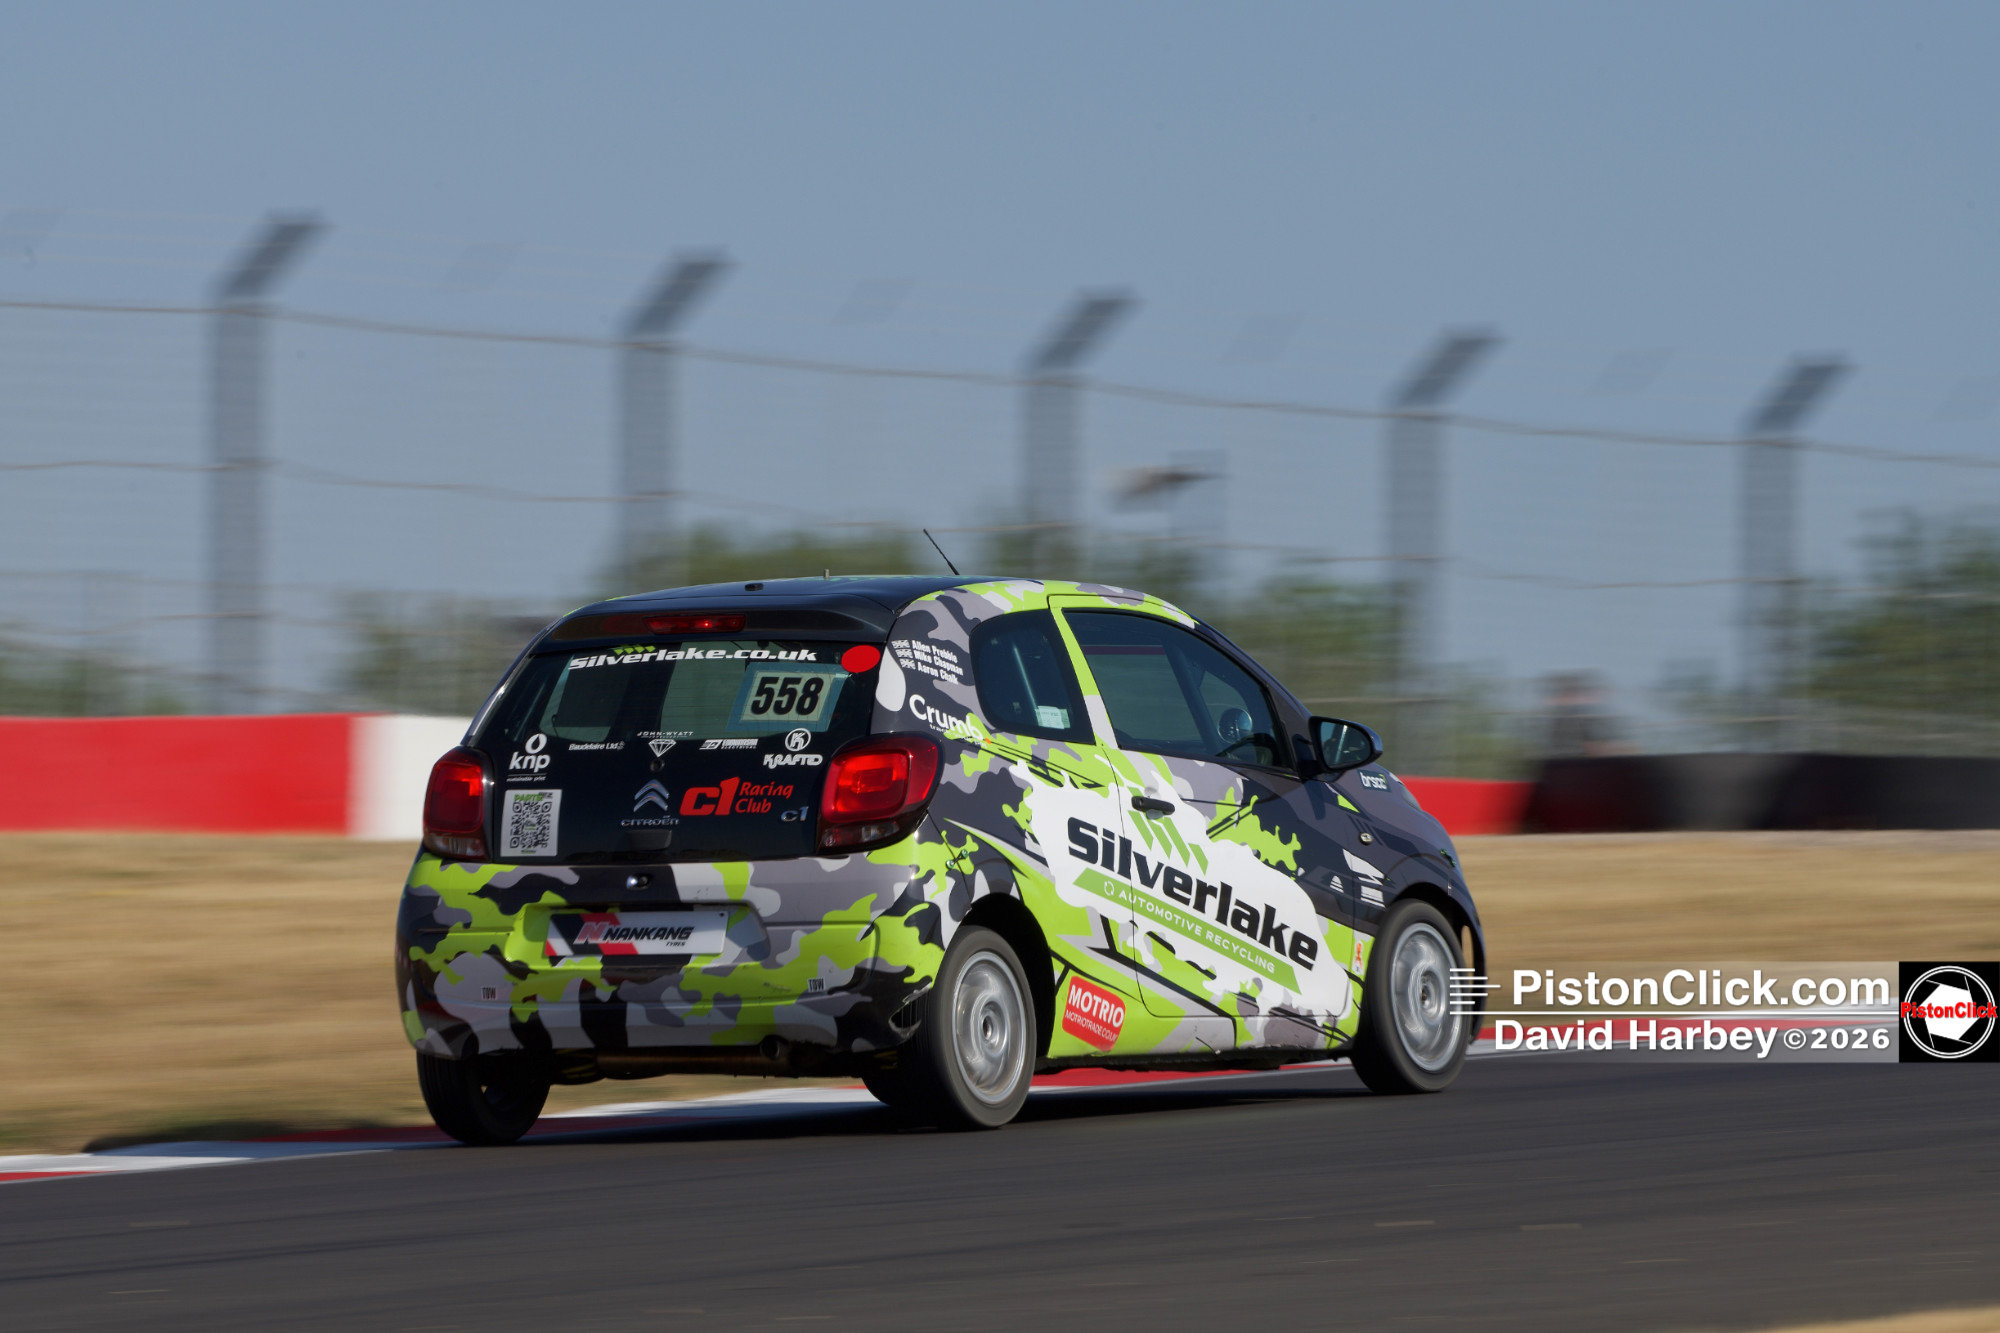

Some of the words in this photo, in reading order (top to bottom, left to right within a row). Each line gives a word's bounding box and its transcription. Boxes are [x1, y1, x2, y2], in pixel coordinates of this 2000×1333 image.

[568, 646, 817, 670] Silverlake.co.uk
[751, 676, 824, 715] 558
[909, 694, 983, 740] Crumb
[606, 742, 618, 750] Ltd
[509, 752, 550, 773] knp
[680, 776, 740, 816] C1
[739, 782, 794, 799] Racing
[735, 799, 772, 814] Club
[1067, 816, 1318, 971] Silverlake
[602, 926, 695, 941] NANKANG
[1119, 889, 1202, 936] AUTOMOTIVE
[1205, 931, 1276, 974] RECYCLING
[482, 986, 496, 1000] TOW
[807, 978, 824, 991] TOW
[1068, 984, 1125, 1028] MOTRIO
